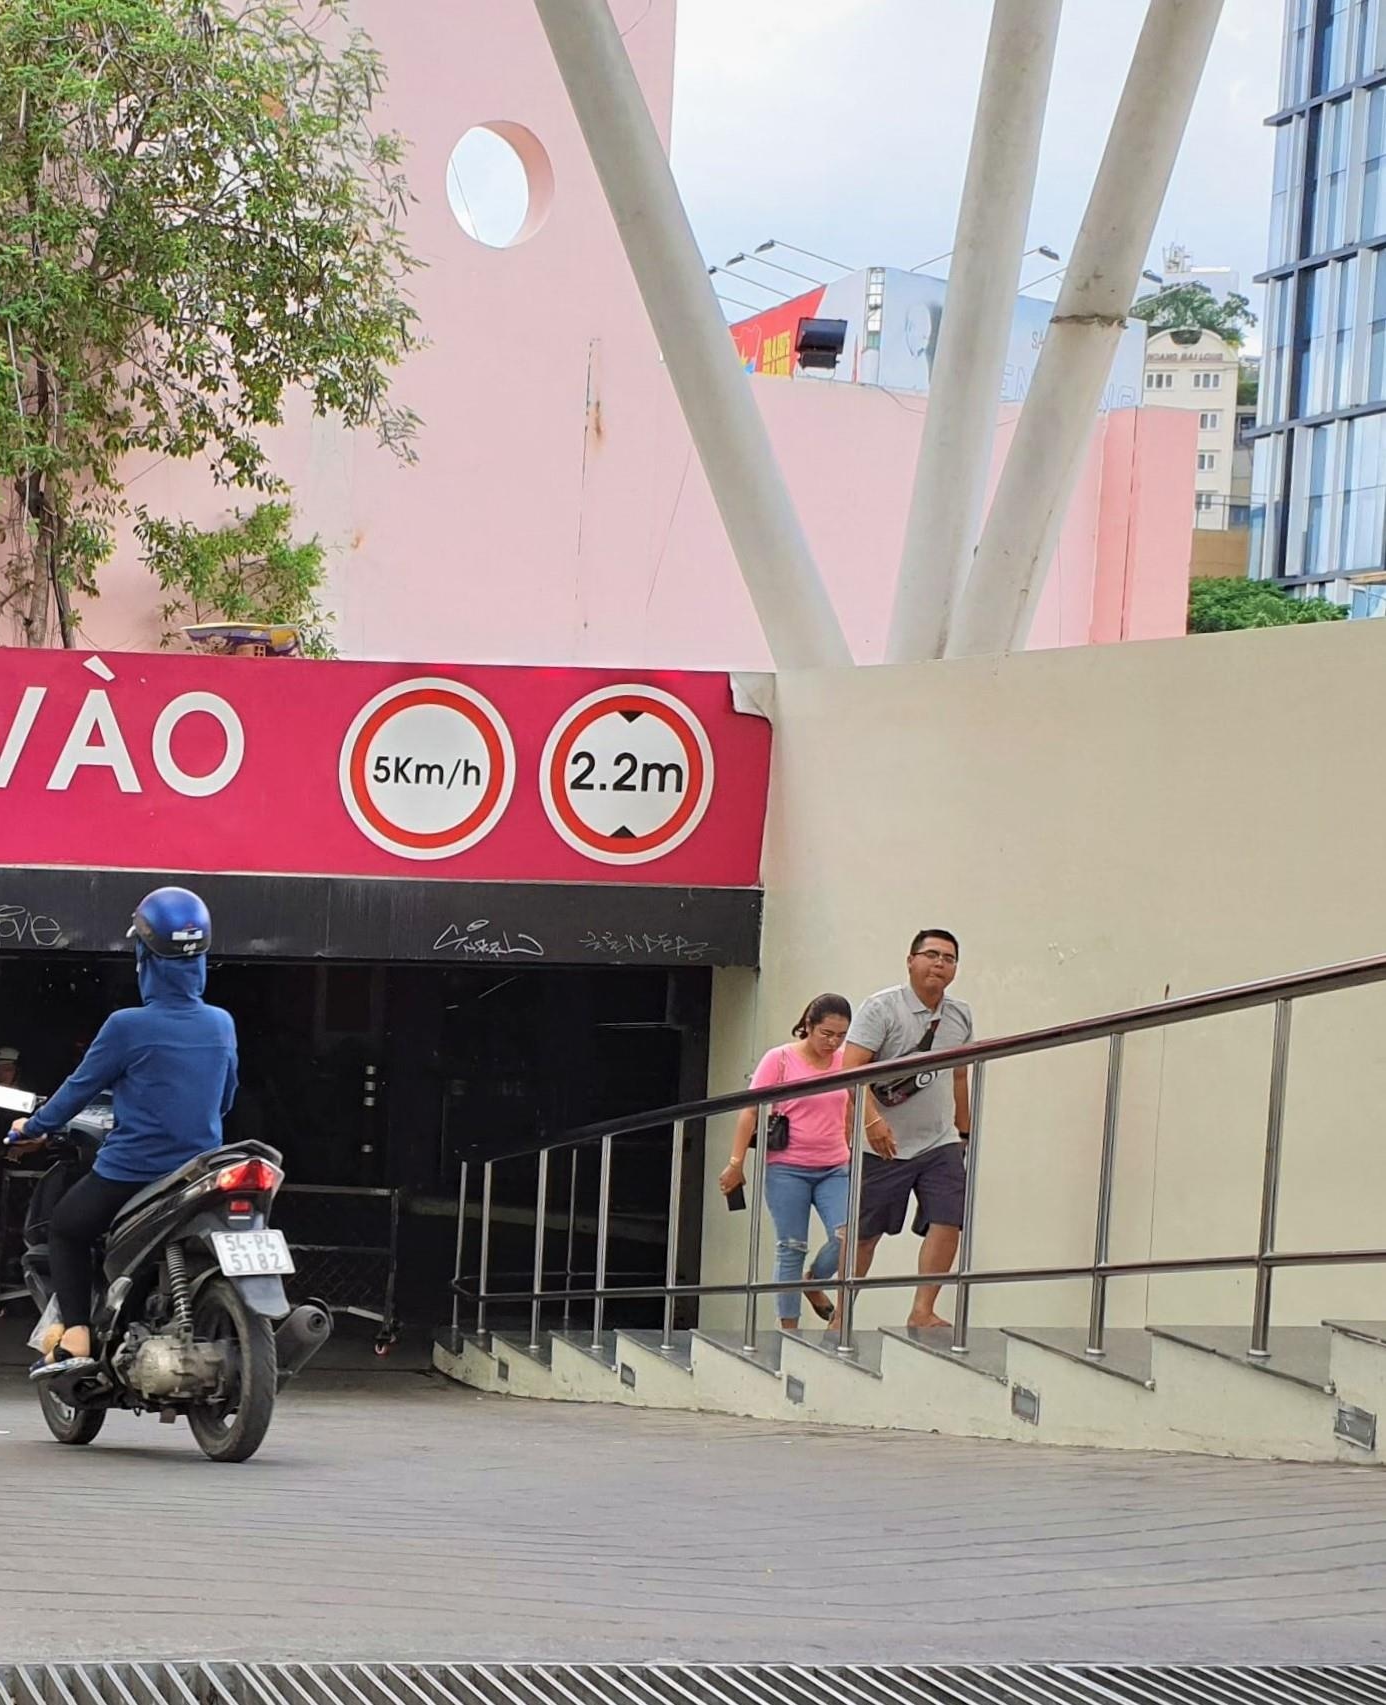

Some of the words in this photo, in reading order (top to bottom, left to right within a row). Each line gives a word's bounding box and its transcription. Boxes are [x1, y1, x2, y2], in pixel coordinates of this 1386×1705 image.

[372, 756, 481, 790] 5Km/h
[570, 751, 684, 793] 2.2m
[230, 1253, 283, 1271] 5182
